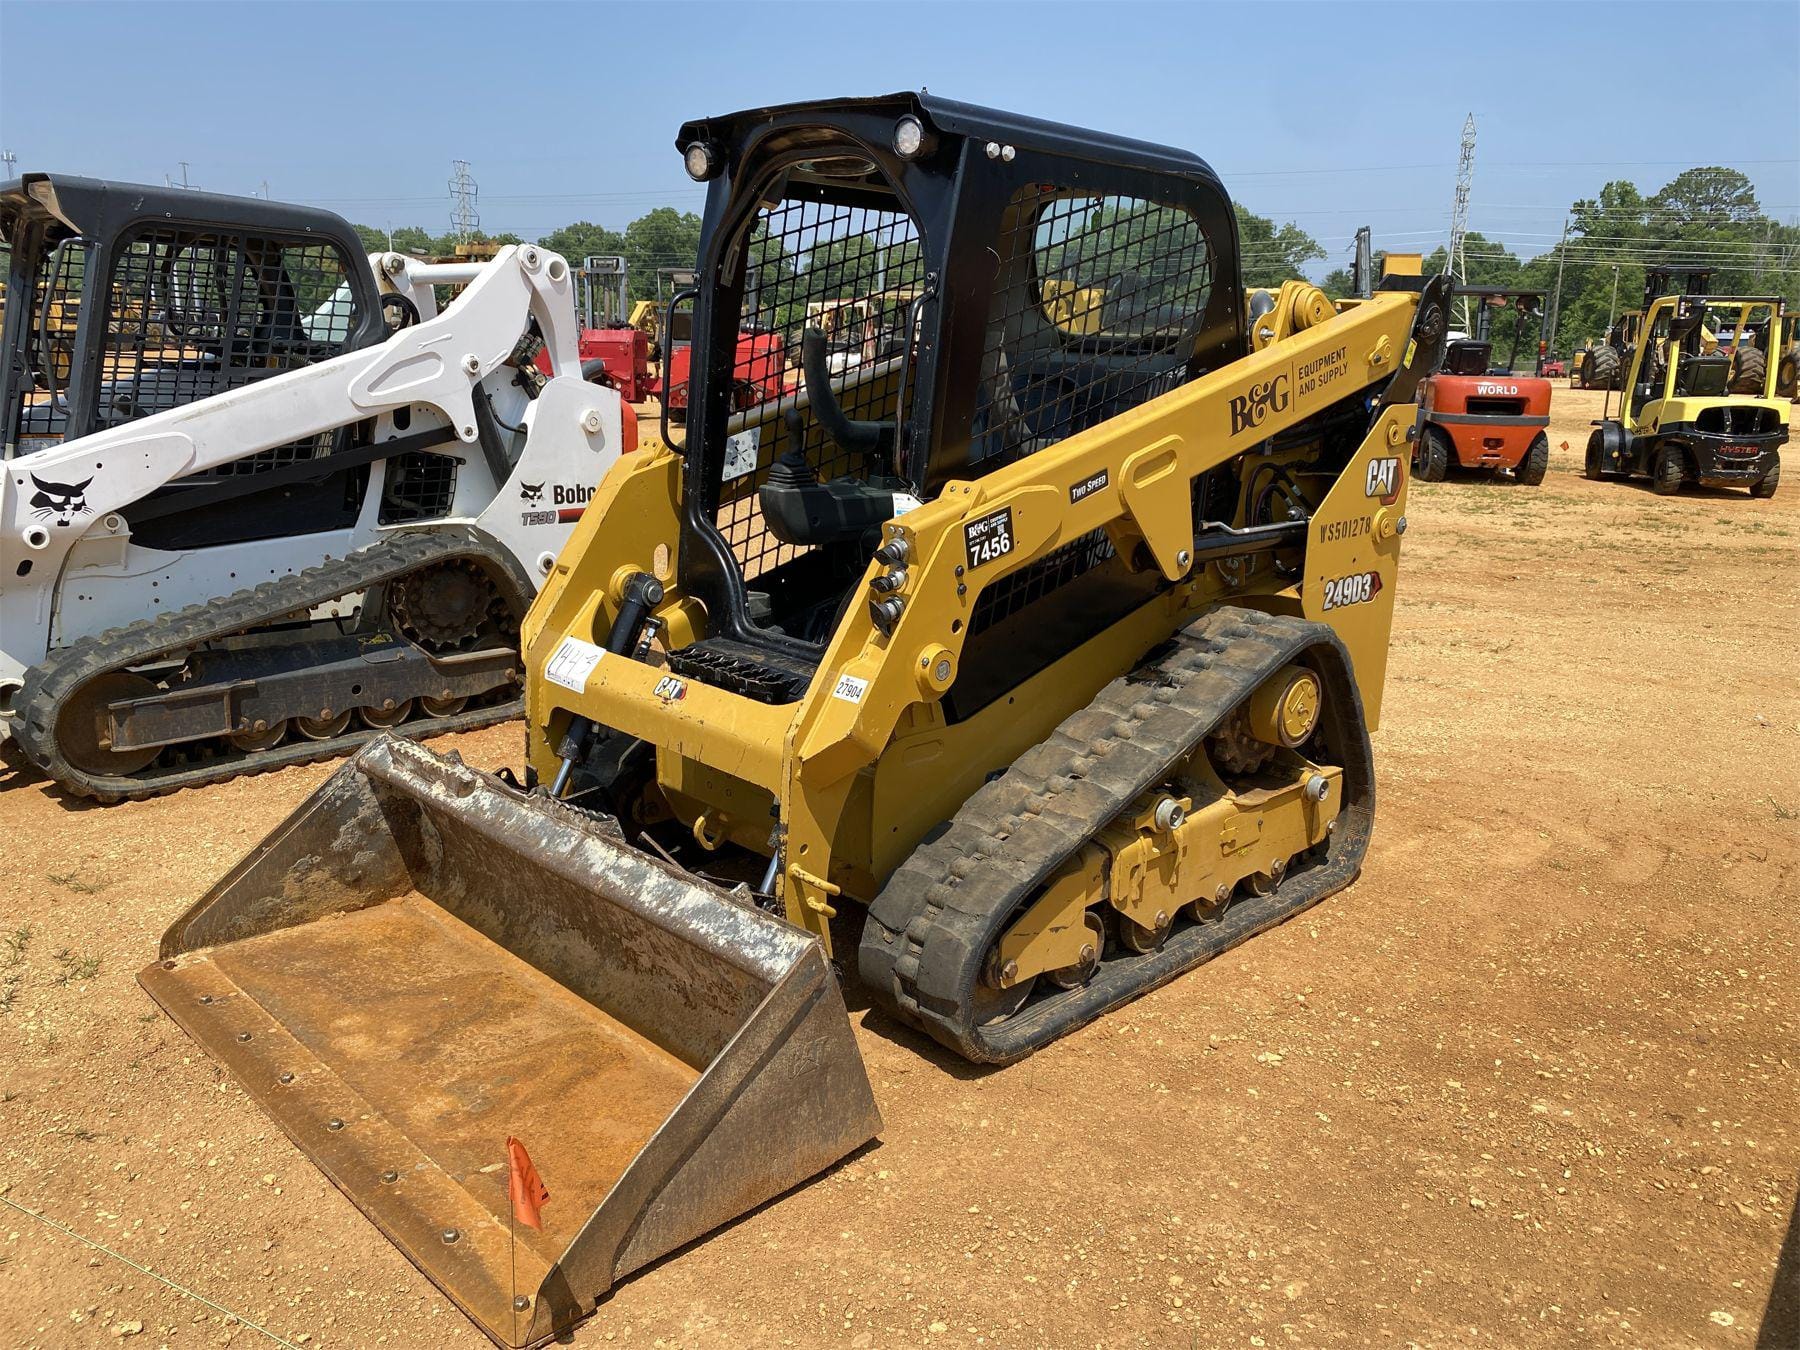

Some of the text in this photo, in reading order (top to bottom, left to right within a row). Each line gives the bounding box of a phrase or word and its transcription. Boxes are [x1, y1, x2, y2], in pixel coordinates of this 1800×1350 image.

[1298, 346, 1347, 381] EQUIPMENT
[1298, 361, 1348, 398] AND SUPPLY
[1228, 372, 1290, 438] B&G
[1477, 385, 1518, 395] WORLD
[1719, 445, 1758, 455] HYSTER
[1366, 459, 1398, 497] CAT
[521, 510, 557, 526] T590
[970, 532, 1010, 567] 7456
[1323, 573, 1373, 611] 249D3
[654, 676, 683, 700] CAT
[836, 681, 863, 699] 27904
